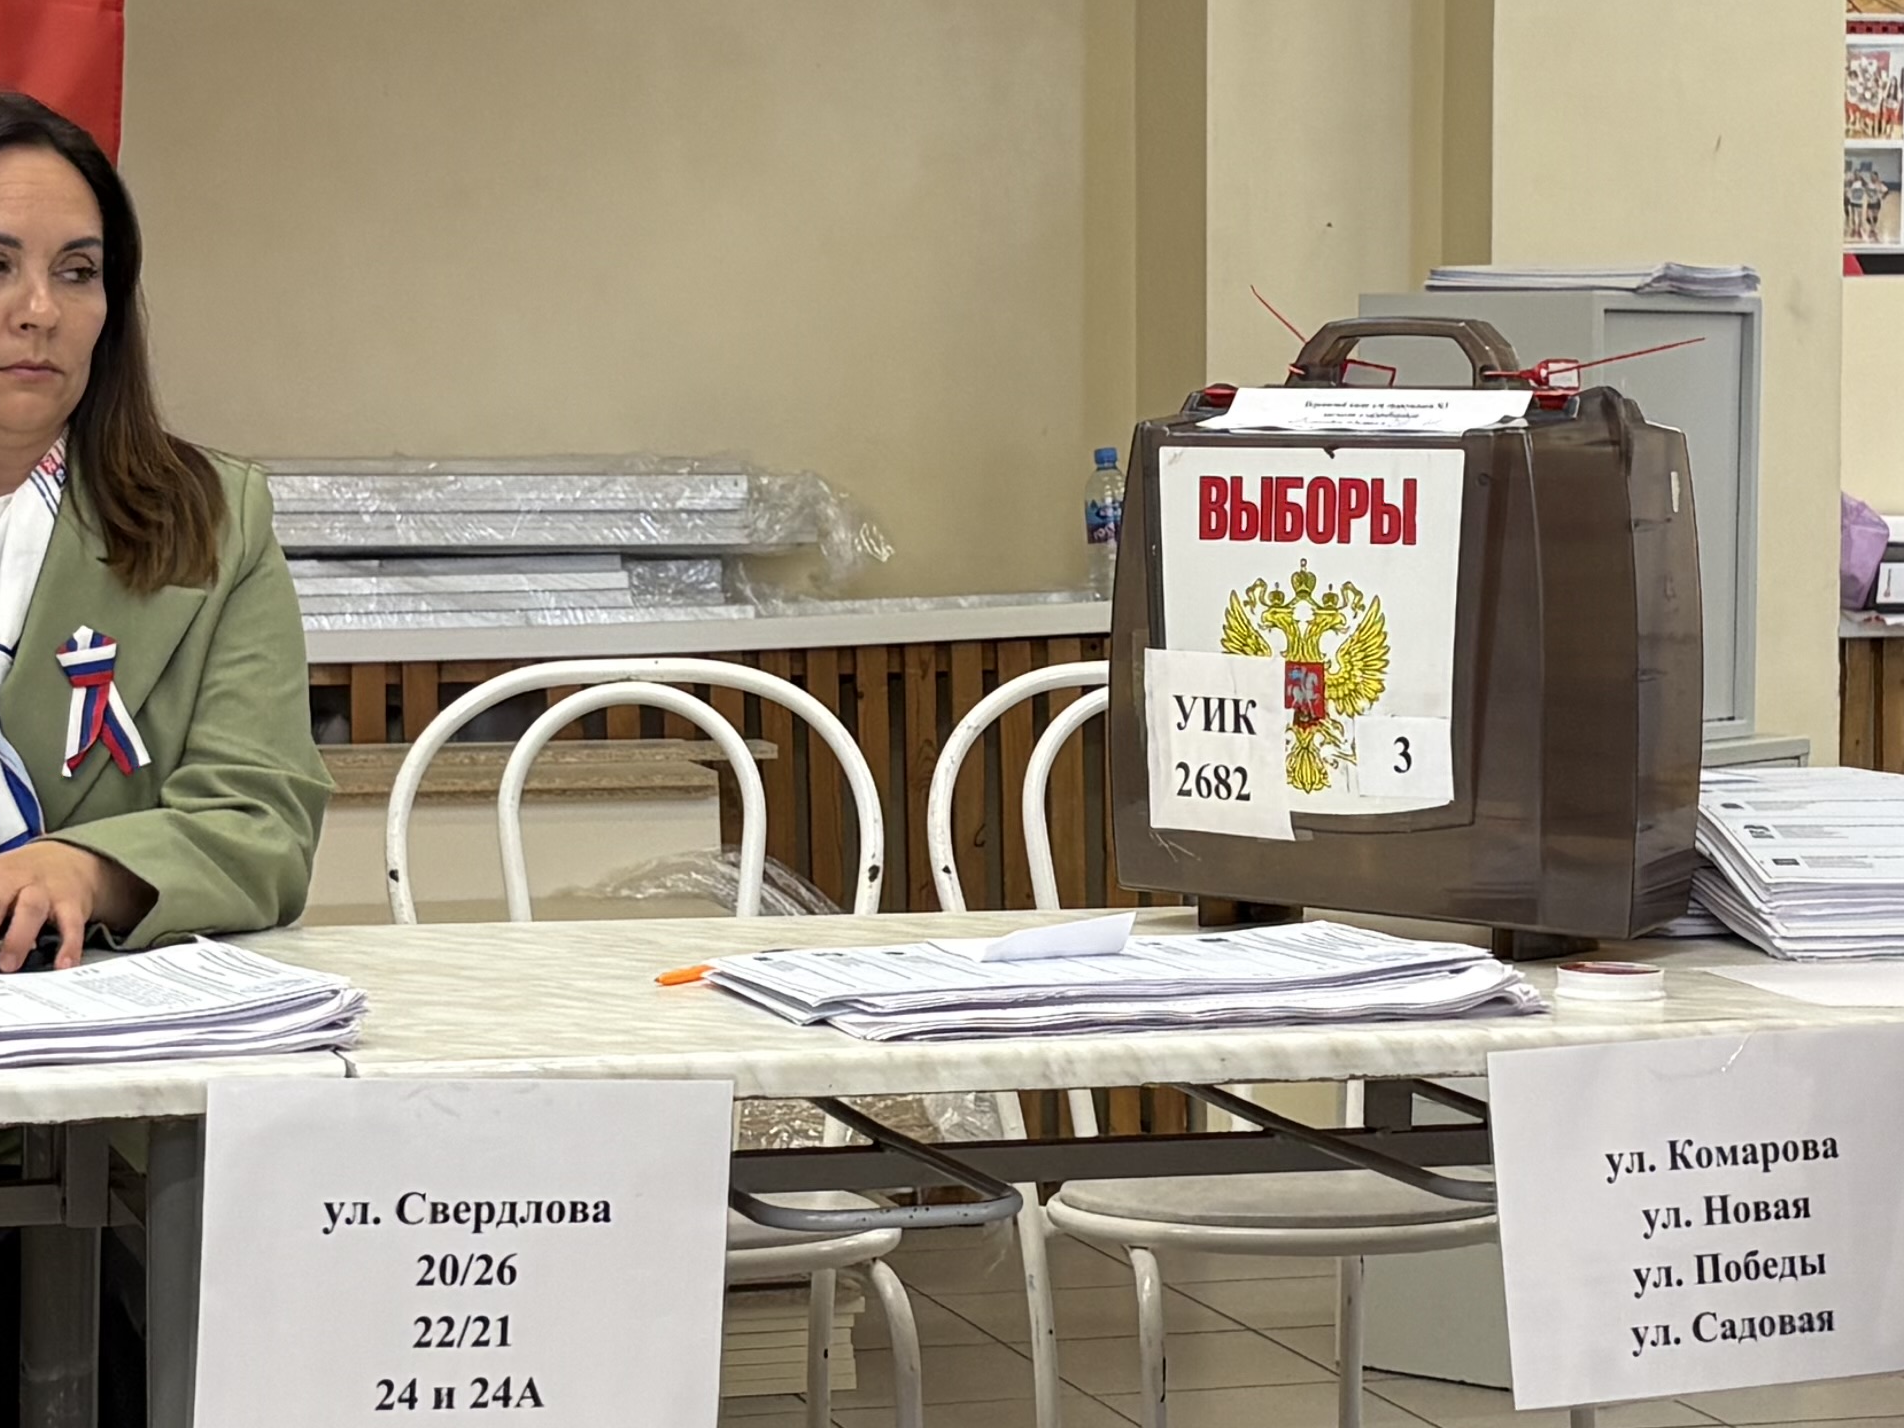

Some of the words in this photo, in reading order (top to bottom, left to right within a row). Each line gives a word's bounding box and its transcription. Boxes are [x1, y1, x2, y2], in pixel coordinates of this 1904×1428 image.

[1198, 475, 1418, 546] ВЫБОРЫ
[1173, 694, 1257, 736] УИК
[1393, 736, 1412, 774] 3
[1175, 761, 1251, 802] 2682
[1605, 1151, 1657, 1185] ул.
[1668, 1137, 1840, 1173] Комарова
[322, 1201, 381, 1235] ул.
[395, 1191, 612, 1234] Свердлова
[1641, 1207, 1693, 1240] ул.
[1703, 1194, 1811, 1226] Новая
[415, 1253, 517, 1287] 20/26
[1632, 1265, 1684, 1299] ул.
[1695, 1249, 1826, 1285] Победы
[412, 1314, 511, 1349] 22/21
[1631, 1324, 1681, 1358] ул.
[1692, 1310, 1835, 1344] Садовая
[374, 1377, 419, 1411] 24
[432, 1386, 456, 1410] и
[469, 1376, 544, 1410] 24А
